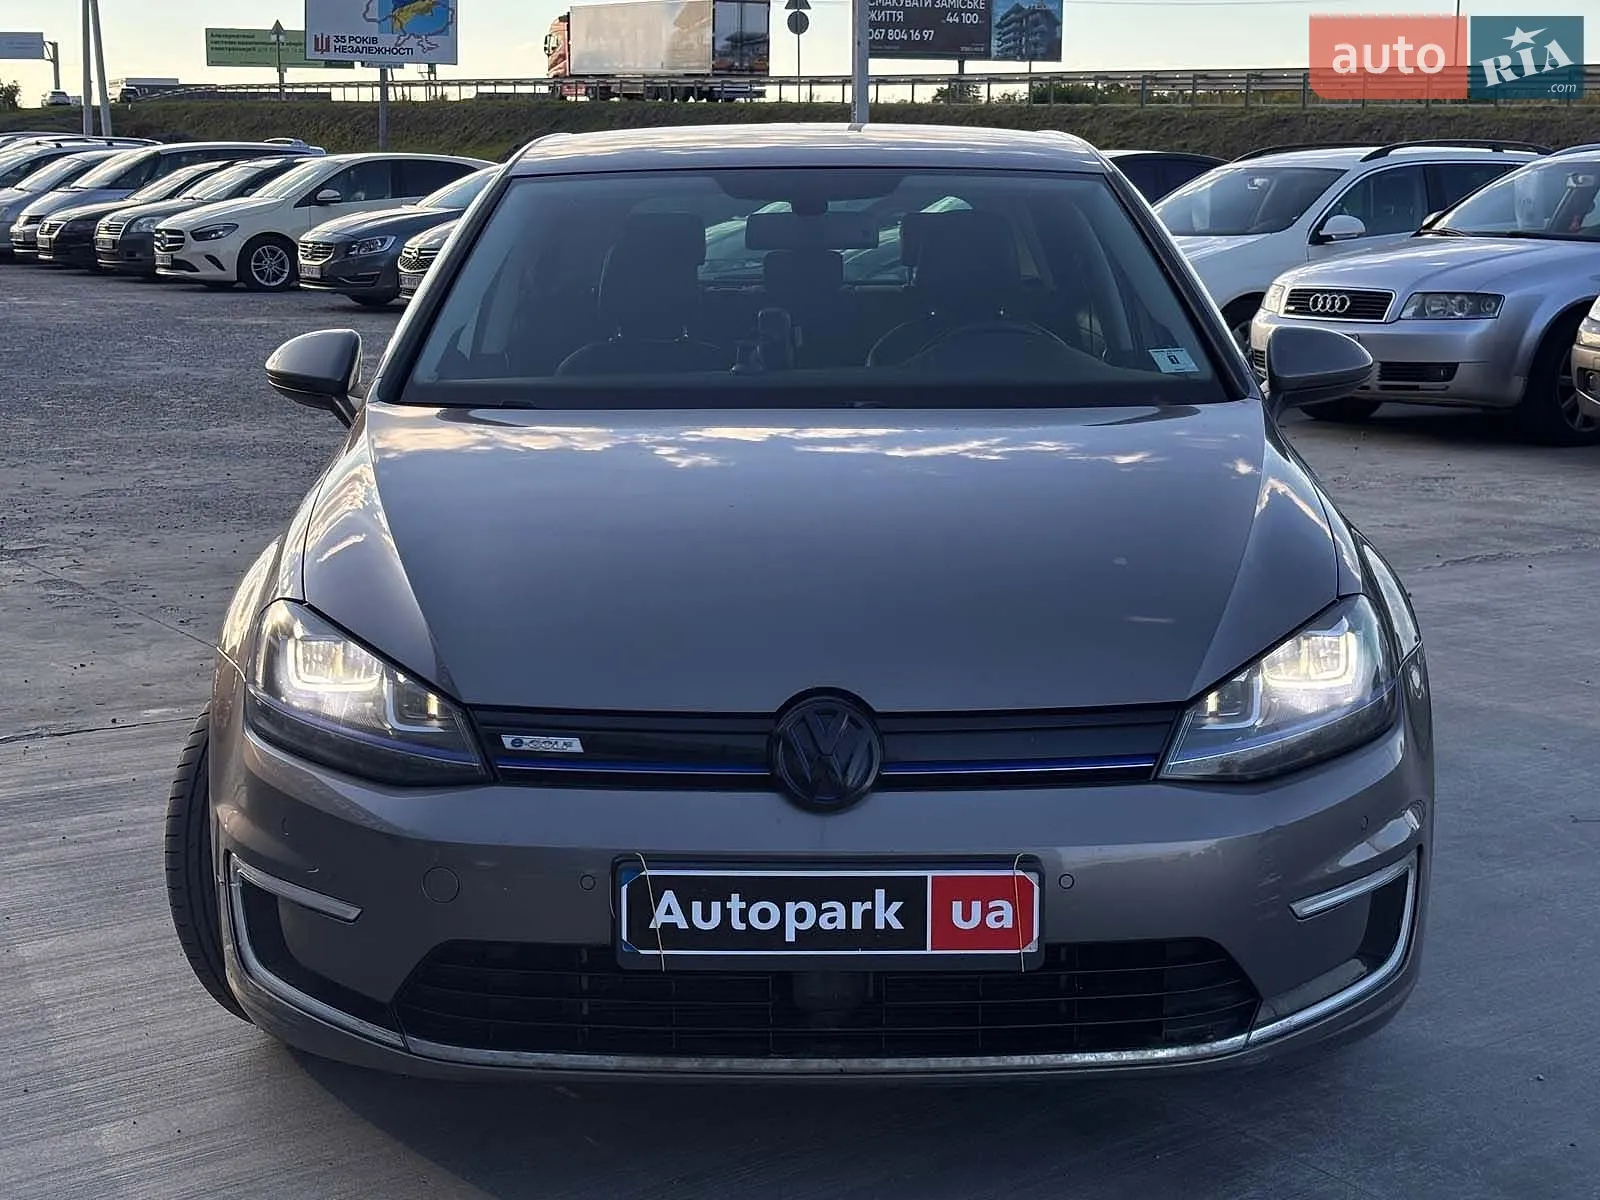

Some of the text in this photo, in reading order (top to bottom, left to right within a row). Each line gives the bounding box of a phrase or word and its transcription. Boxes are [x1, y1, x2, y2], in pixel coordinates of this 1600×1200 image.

[868, 10, 904, 22] ЖИТТЯ
[946, 12, 960, 24] 44
[961, 13, 979, 24] 100
[348, 35, 378, 45] РОКІВ
[887, 29, 908, 41] 804
[909, 29, 921, 41] 16
[922, 29, 935, 41] 97
[333, 45, 414, 56] НЕЗАЛЕЖНОСТІ
[648, 889, 1014, 943] Autopark ua
